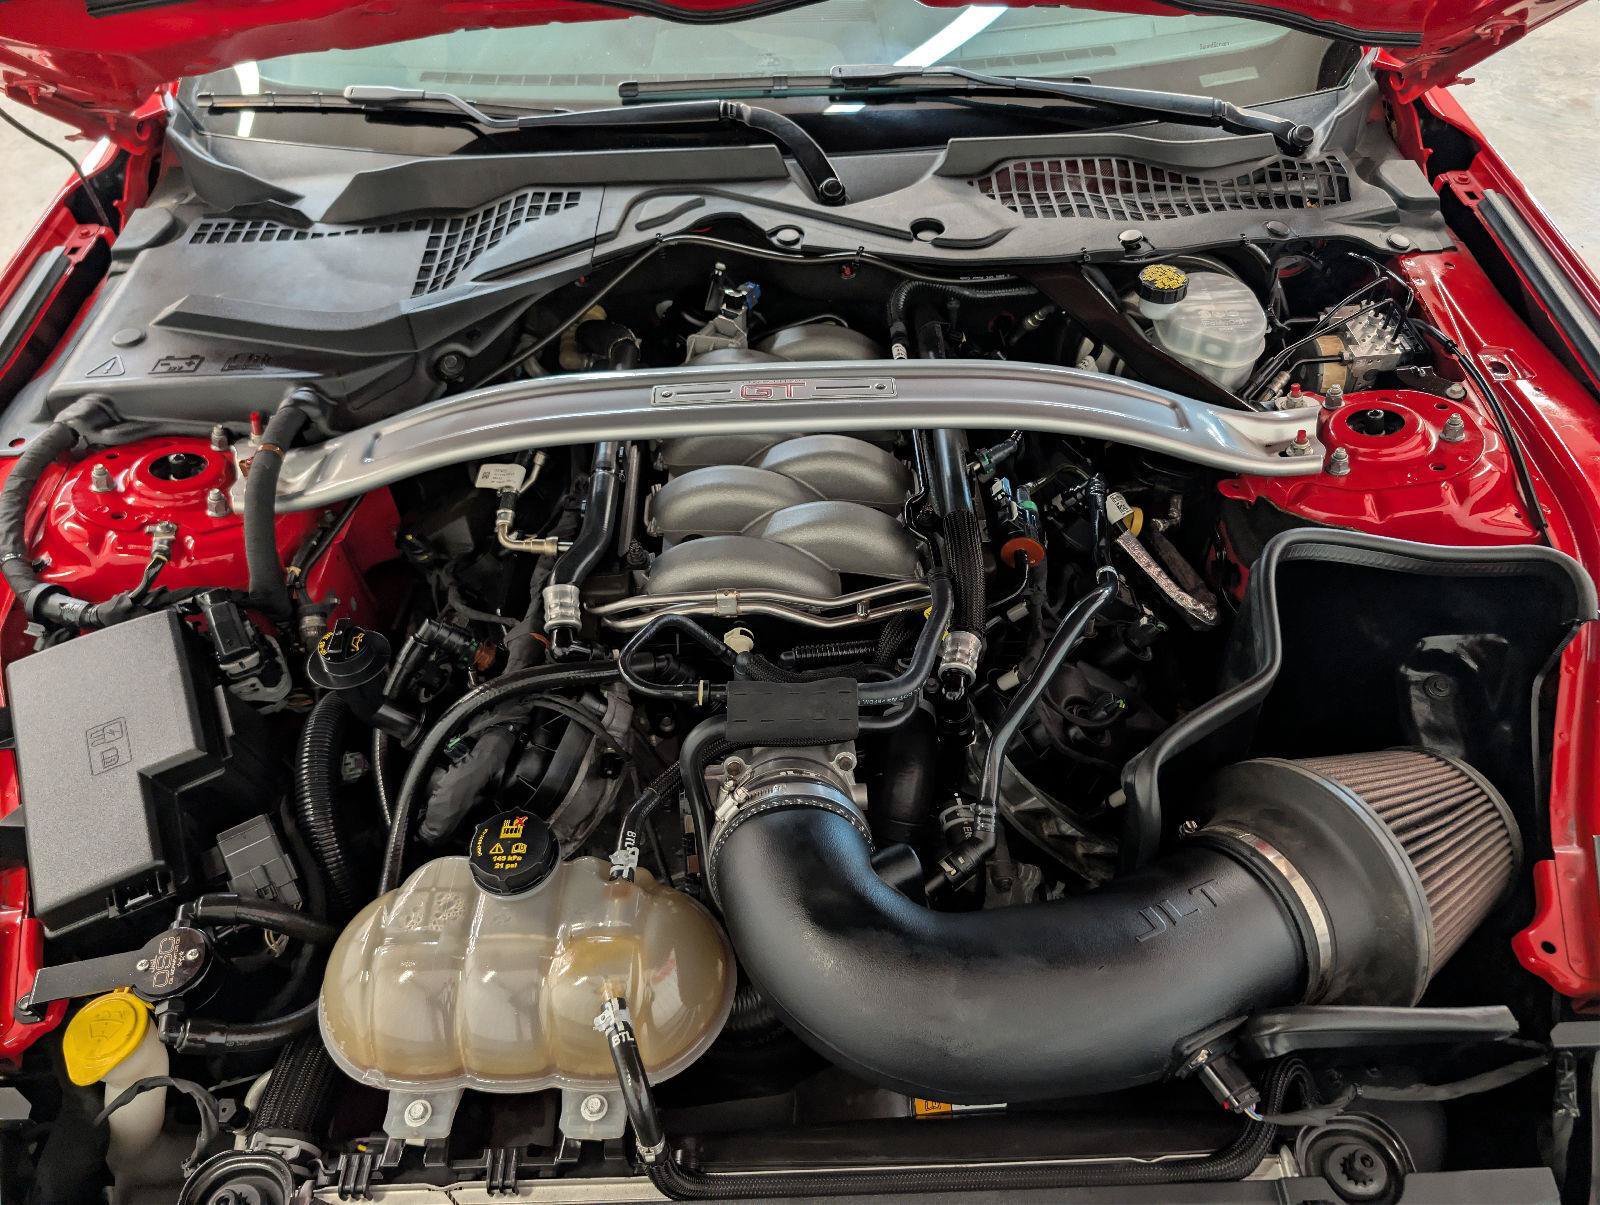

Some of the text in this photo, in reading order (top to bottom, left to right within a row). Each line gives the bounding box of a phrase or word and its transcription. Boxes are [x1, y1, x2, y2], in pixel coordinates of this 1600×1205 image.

[740, 383, 807, 400] GT
[1135, 879, 1222, 942] JLT
[611, 1030, 635, 1048] BTL
